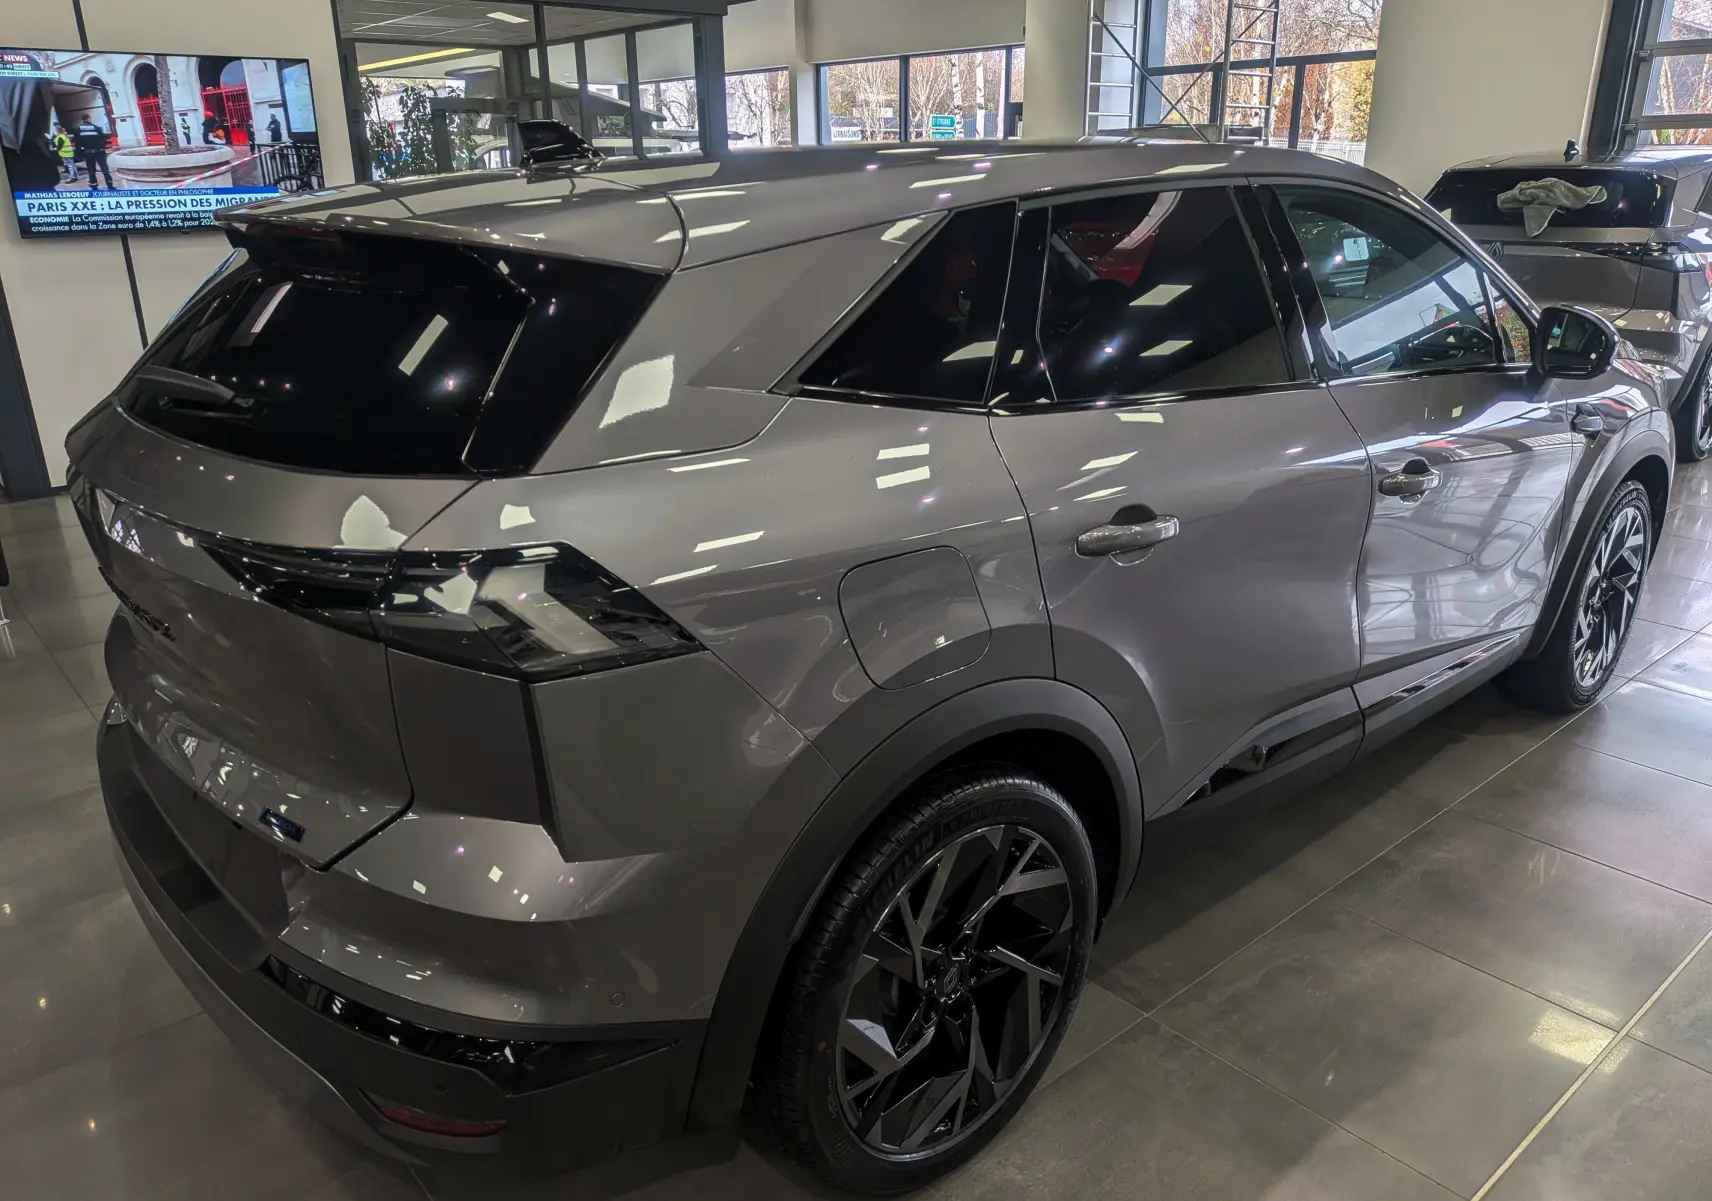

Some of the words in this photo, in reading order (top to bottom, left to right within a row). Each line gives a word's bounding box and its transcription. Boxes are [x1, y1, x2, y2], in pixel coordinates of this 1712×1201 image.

[3, 54, 28, 62] NEWS
[27, 202, 67, 212] PARIS
[70, 201, 97, 211] XXE
[108, 201, 123, 210] LA
[126, 199, 188, 210] PRESSION
[191, 198, 212, 208] DES
[216, 196, 276, 206] MIGRA
[82, 214, 123, 222] Commission
[124, 212, 164, 221] européenne
[135, 220, 144, 228] de
[145, 219, 161, 228] 1,4%
[184, 219, 199, 228] pour
